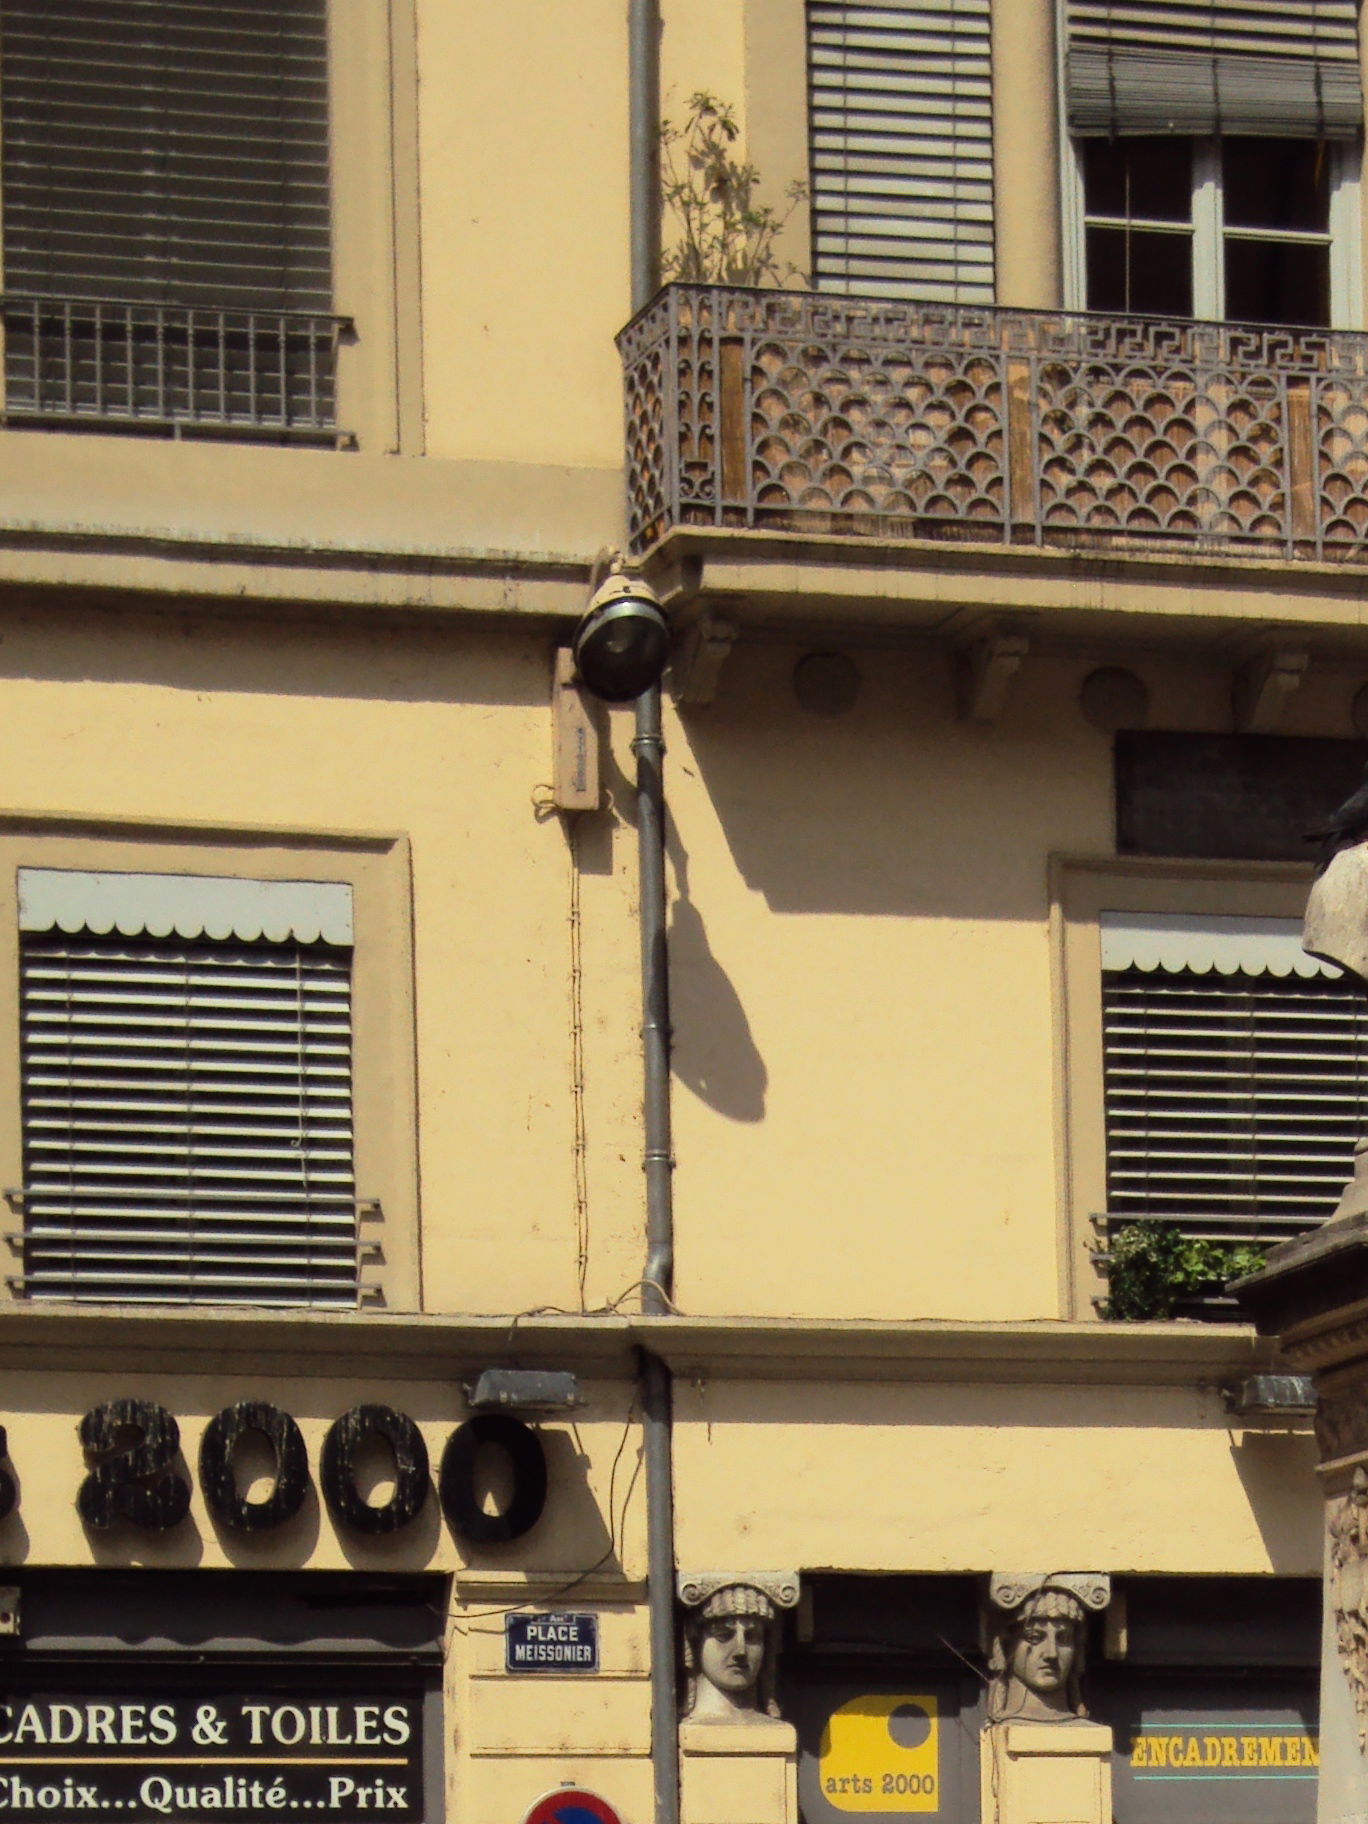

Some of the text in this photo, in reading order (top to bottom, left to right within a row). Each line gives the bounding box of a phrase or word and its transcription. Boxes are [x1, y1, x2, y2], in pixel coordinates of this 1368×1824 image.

[77, 1400, 548, 1544] 2000
[526, 1626, 579, 1642] PLACE
[515, 1644, 592, 1662] MEISSONIER
[191, 1705, 228, 1745] &
[241, 1705, 411, 1746] TOILES
[826, 1773, 935, 1795] arts 2000
